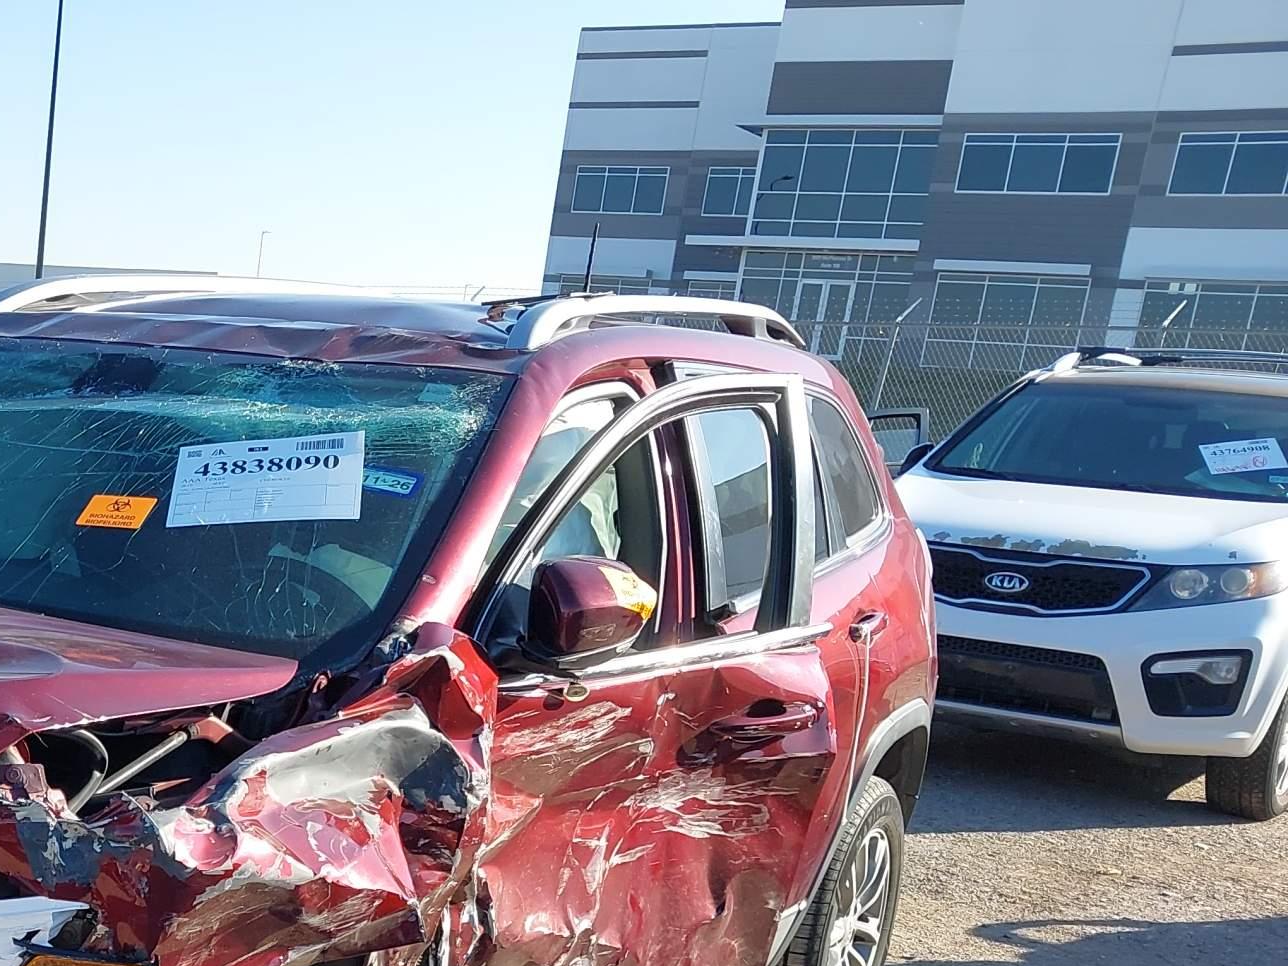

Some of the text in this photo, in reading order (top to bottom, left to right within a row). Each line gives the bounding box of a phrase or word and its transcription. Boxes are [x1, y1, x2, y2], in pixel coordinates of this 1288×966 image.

[1210, 445, 1271, 456] 43764908
[194, 454, 340, 477] 43838090
[88, 513, 136, 521] BIOHAZARD
[992, 575, 1020, 589] KIA
